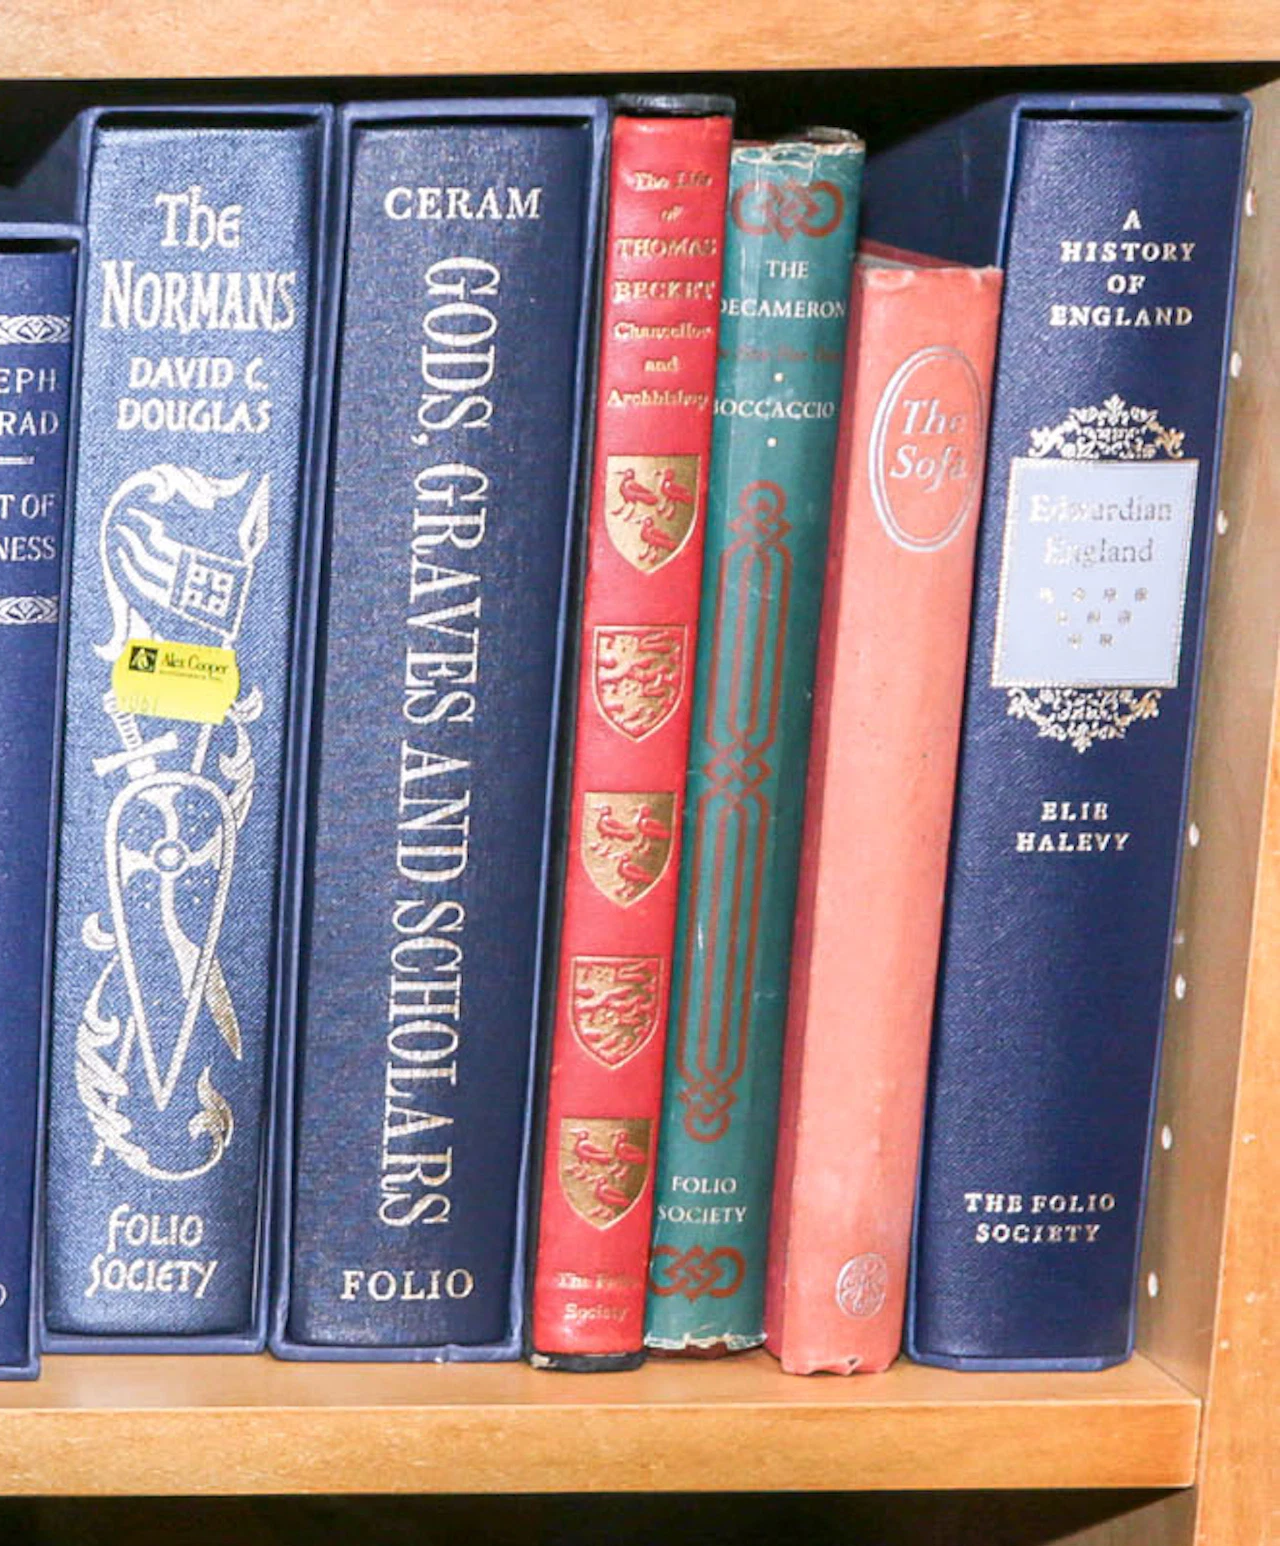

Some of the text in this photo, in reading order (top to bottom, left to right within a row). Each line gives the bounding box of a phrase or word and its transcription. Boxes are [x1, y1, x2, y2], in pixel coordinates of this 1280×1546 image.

[384, 187, 542, 221] CERAM
[154, 185, 241, 250] The
[1122, 209, 1142, 232] A
[615, 237, 717, 259] THOMAS
[1059, 241, 1196, 263] HISTORY
[766, 259, 810, 280] THE
[1106, 273, 1146, 295] OF
[1048, 305, 1193, 327] ENGLAND
[128, 356, 234, 390] DAVID
[644, 356, 679, 373] and
[116, 398, 272, 434] DOUGLAS
[899, 399, 967, 437] The
[889, 443, 968, 492] Sofa
[20, 494, 57, 519] OF
[1028, 493, 1174, 524] Edwardian
[1043, 538, 1155, 566] England
[377, 256, 501, 1228] GODS, GRAVES AND SCHOLARS
[1015, 831, 1130, 853] HALEVY
[671, 1174, 738, 1196] FOLIO
[656, 1203, 748, 1226] SOCIETY
[962, 1192, 1117, 1214] THE FOLIO
[105, 1202, 203, 1248] FOLIO
[974, 1223, 1102, 1244] SOCIETY
[83, 1257, 217, 1300] SOCIETY
[342, 1269, 475, 1301] FOLIO
